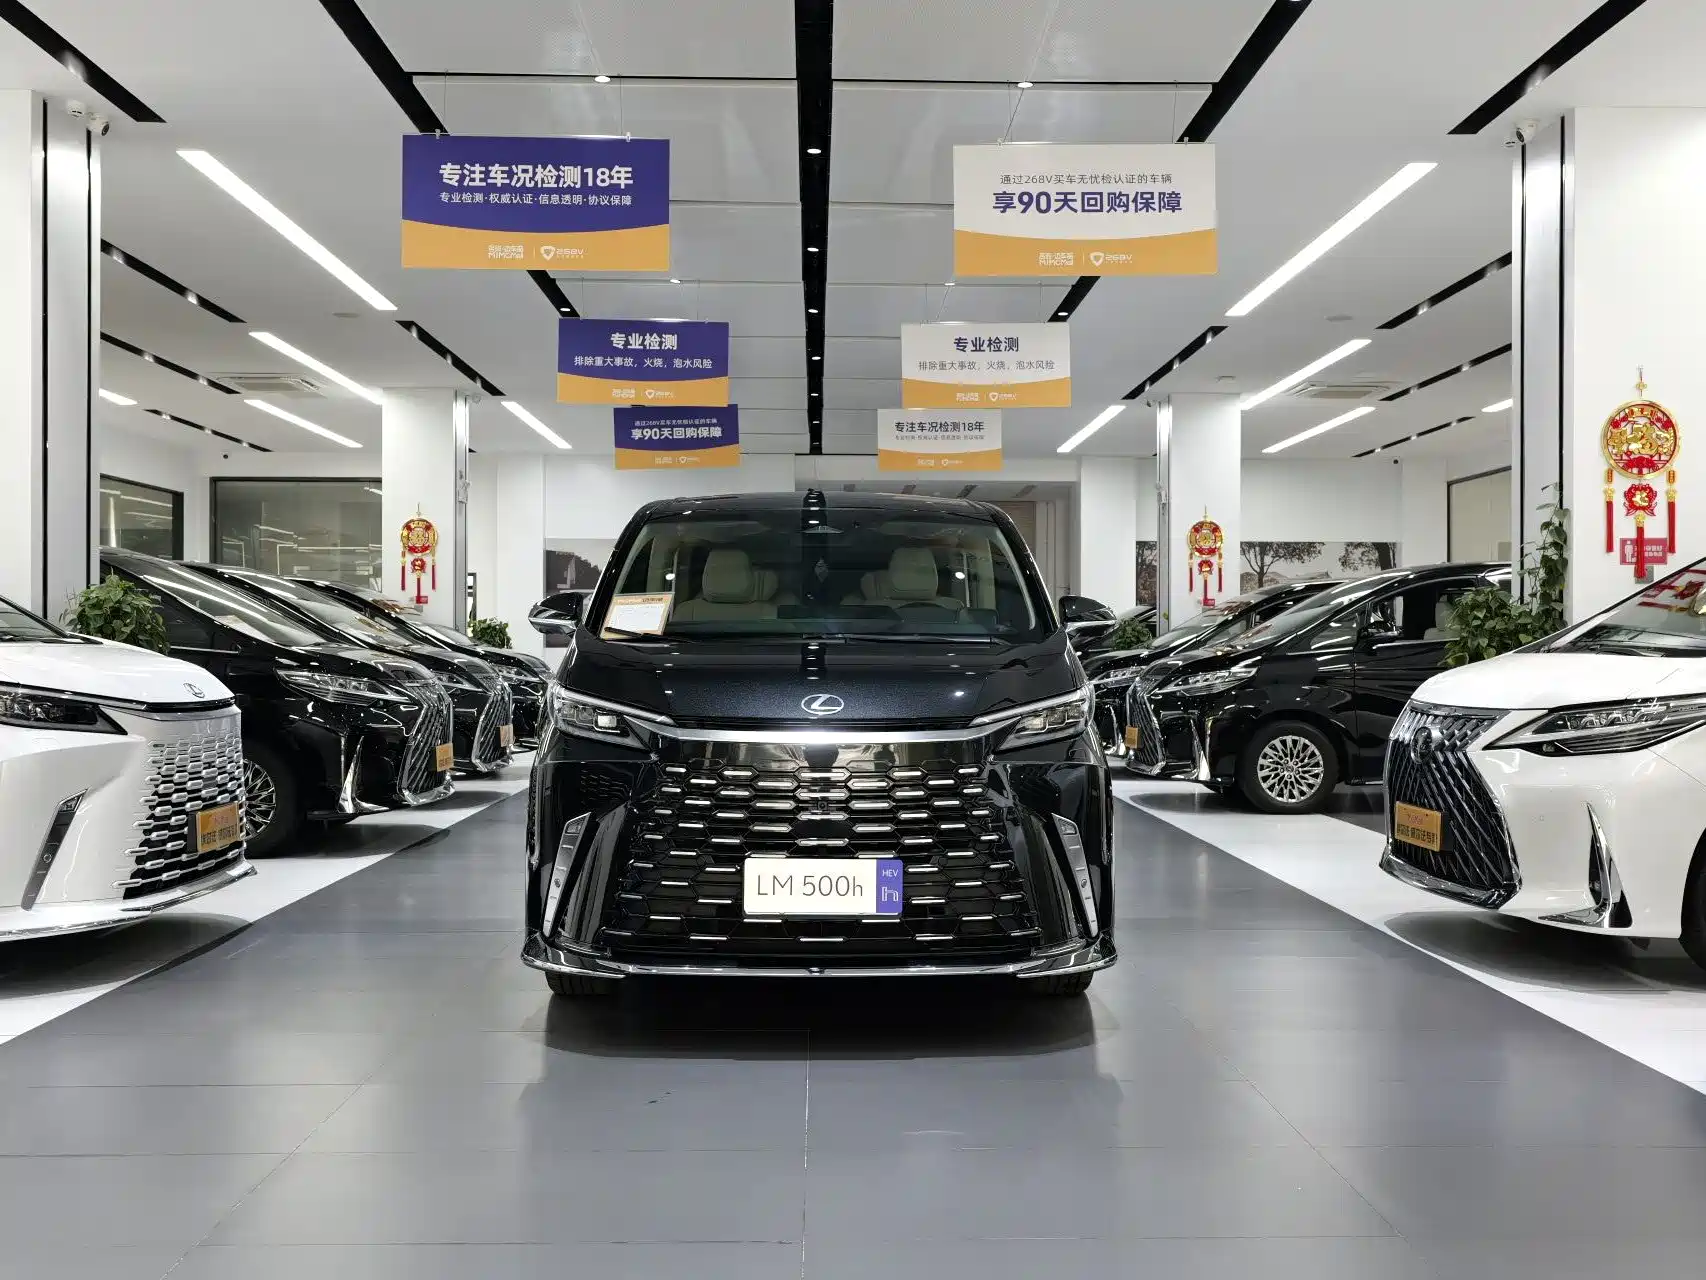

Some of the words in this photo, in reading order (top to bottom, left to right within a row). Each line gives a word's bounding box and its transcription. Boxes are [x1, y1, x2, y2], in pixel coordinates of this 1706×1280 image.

[439, 162, 634, 189] 专注车况检测18年
[1000, 174, 1173, 185] 通过268V买车无忧检认证的车辆
[992, 190, 1183, 214] 享90天回购保障
[610, 332, 678, 351] 专业检测
[953, 336, 1019, 353] 专业检测
[631, 427, 722, 440] 享90天回购保障
[895, 421, 985, 433] 专注车况检测18年
[882, 869, 899, 877] HEV
[757, 875, 793, 896] LM
[802, 875, 863, 897] 500h
